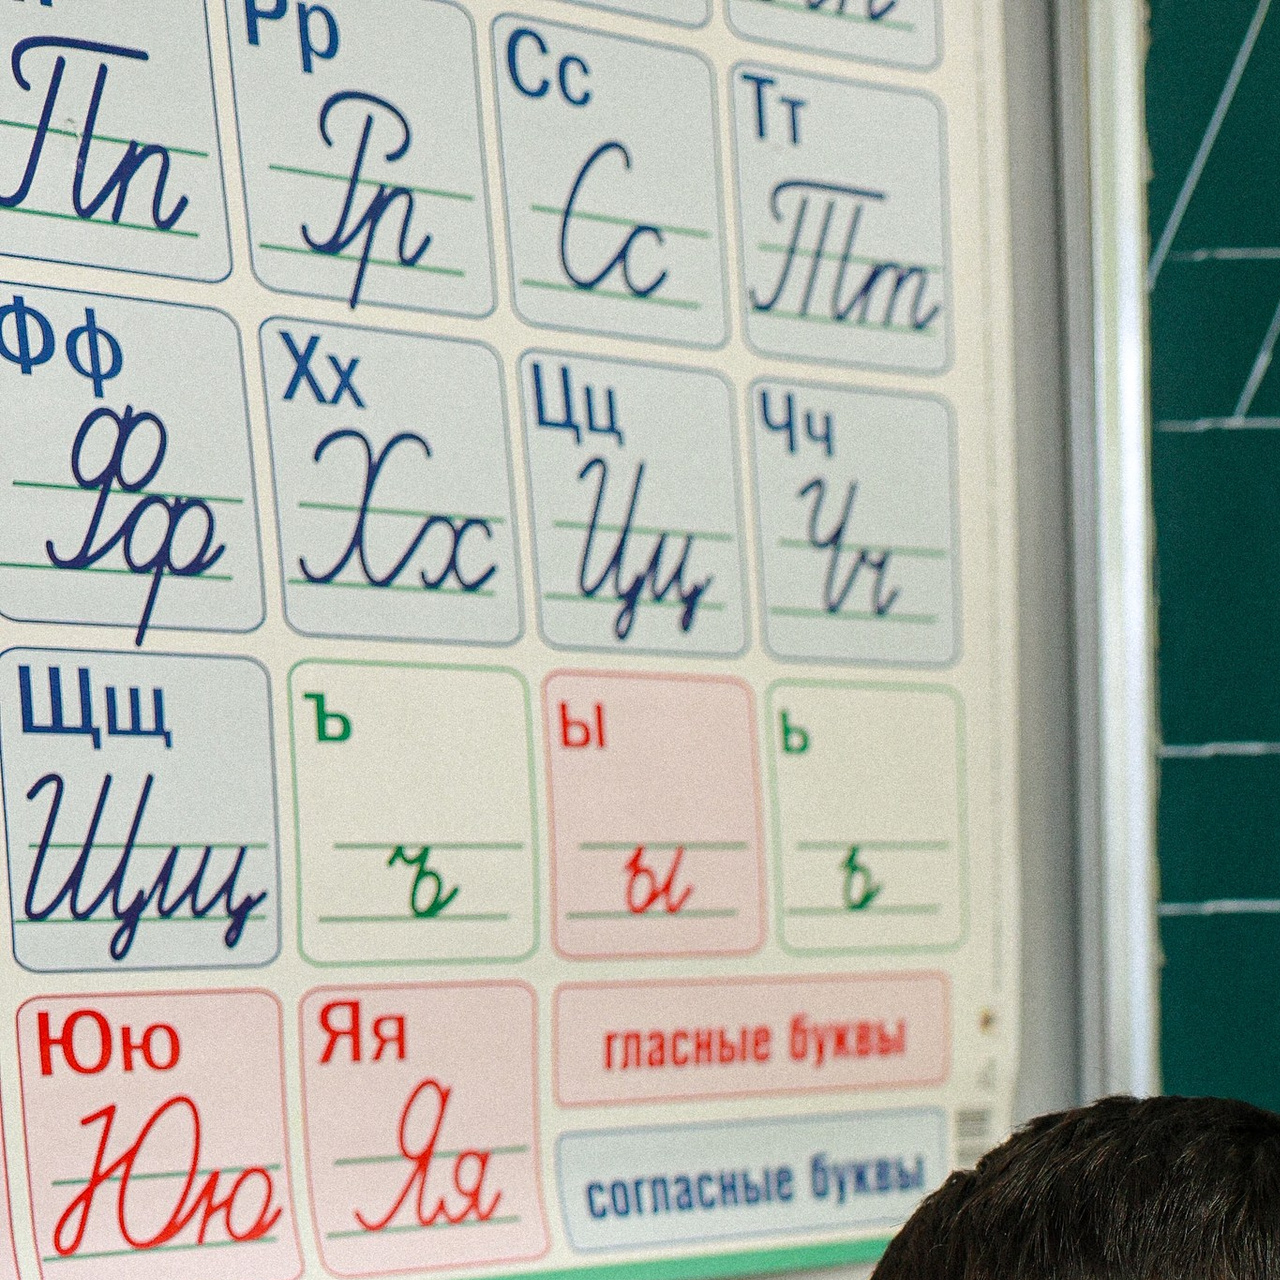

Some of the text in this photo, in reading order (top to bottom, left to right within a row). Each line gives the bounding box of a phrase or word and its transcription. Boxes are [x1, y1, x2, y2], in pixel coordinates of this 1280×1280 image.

[506, 27, 591, 107] Сс
[741, 72, 806, 146] Тт
[0, 35, 189, 231] Пп
[301, 90, 432, 309] Рр
[560, 141, 667, 298] Сс
[750, 178, 938, 331] Тт
[0, 294, 123, 399] Фф
[279, 331, 365, 409] Хх
[532, 363, 624, 445] Цц
[760, 389, 834, 458] Чч
[46, 404, 226, 647] Фф
[299, 429, 497, 591] Хх
[579, 457, 713, 641] Цц
[799, 478, 901, 616] Чч
[18, 665, 173, 750] Щщ
[25, 773, 268, 961] Щщ
[36, 1008, 181, 1076] Юю
[318, 999, 407, 1065] Яя
[603, 1012, 906, 1072] гласные буквы
[53, 1094, 283, 1258] Юю
[355, 1078, 502, 1232] Яя
[586, 1153, 927, 1220] согласные буквы
